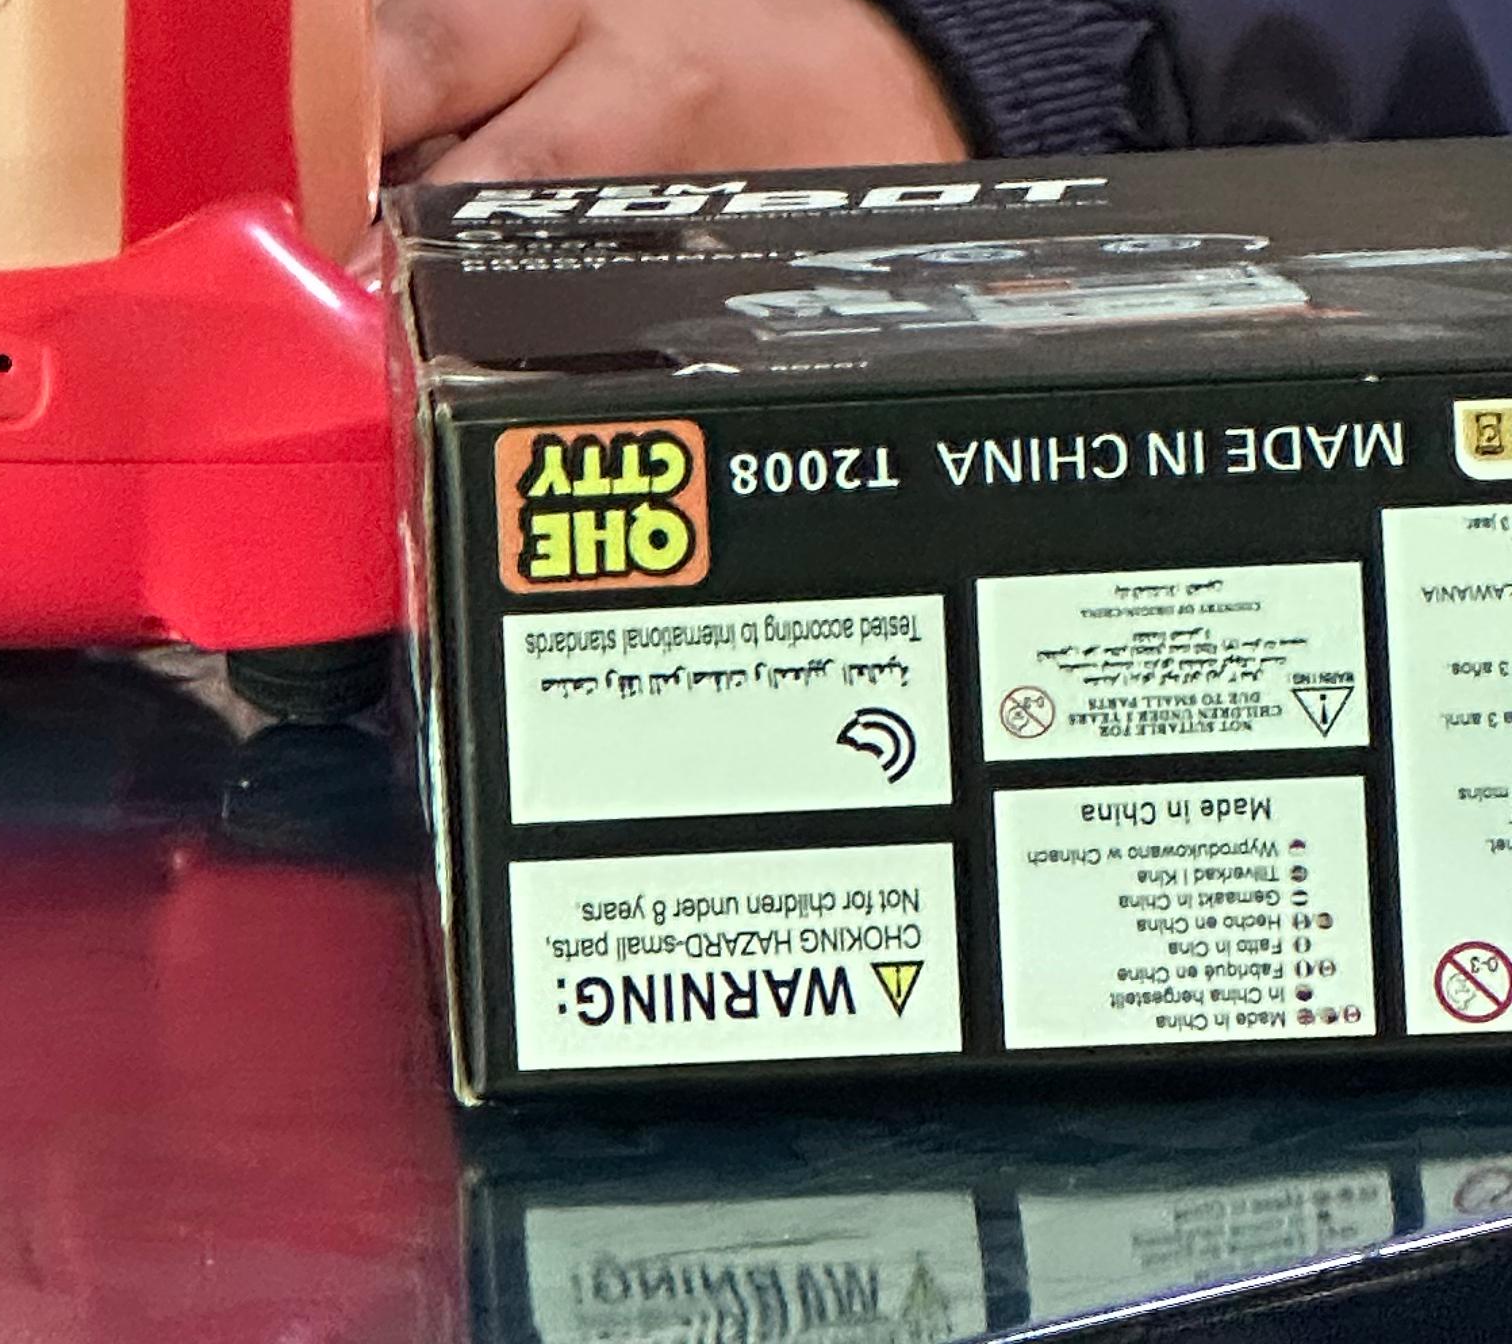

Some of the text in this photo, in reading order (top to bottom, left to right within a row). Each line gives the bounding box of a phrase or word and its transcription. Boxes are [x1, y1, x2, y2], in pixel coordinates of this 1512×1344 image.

[451, 177, 1108, 219] ROBOT
[936, 420, 1406, 486] MADE IN CHINA
[728, 445, 901, 495] T2008
[529, 502, 689, 578] QHE
[524, 614, 922, 659] Tested according to international standards
[1201, 692, 1223, 706] TO
[1227, 691, 1260, 705] DUE
[1197, 704, 1282, 720] CHILDREN
[1135, 719, 1214, 735] SUITABLE
[1079, 796, 1272, 828] Made in China
[575, 887, 921, 926] Not for children under 8 years.
[1118, 894, 1171, 911] China
[1136, 917, 1190, 933] China
[544, 923, 921, 961] CHOKING HAZARD-small parts,
[1469, 956, 1498, 974] 0-3
[555, 966, 856, 1027] WARNING:
[1210, 987, 1262, 1007] China
[1155, 1014, 1208, 1033] China
[1235, 1010, 1286, 1029] Made
